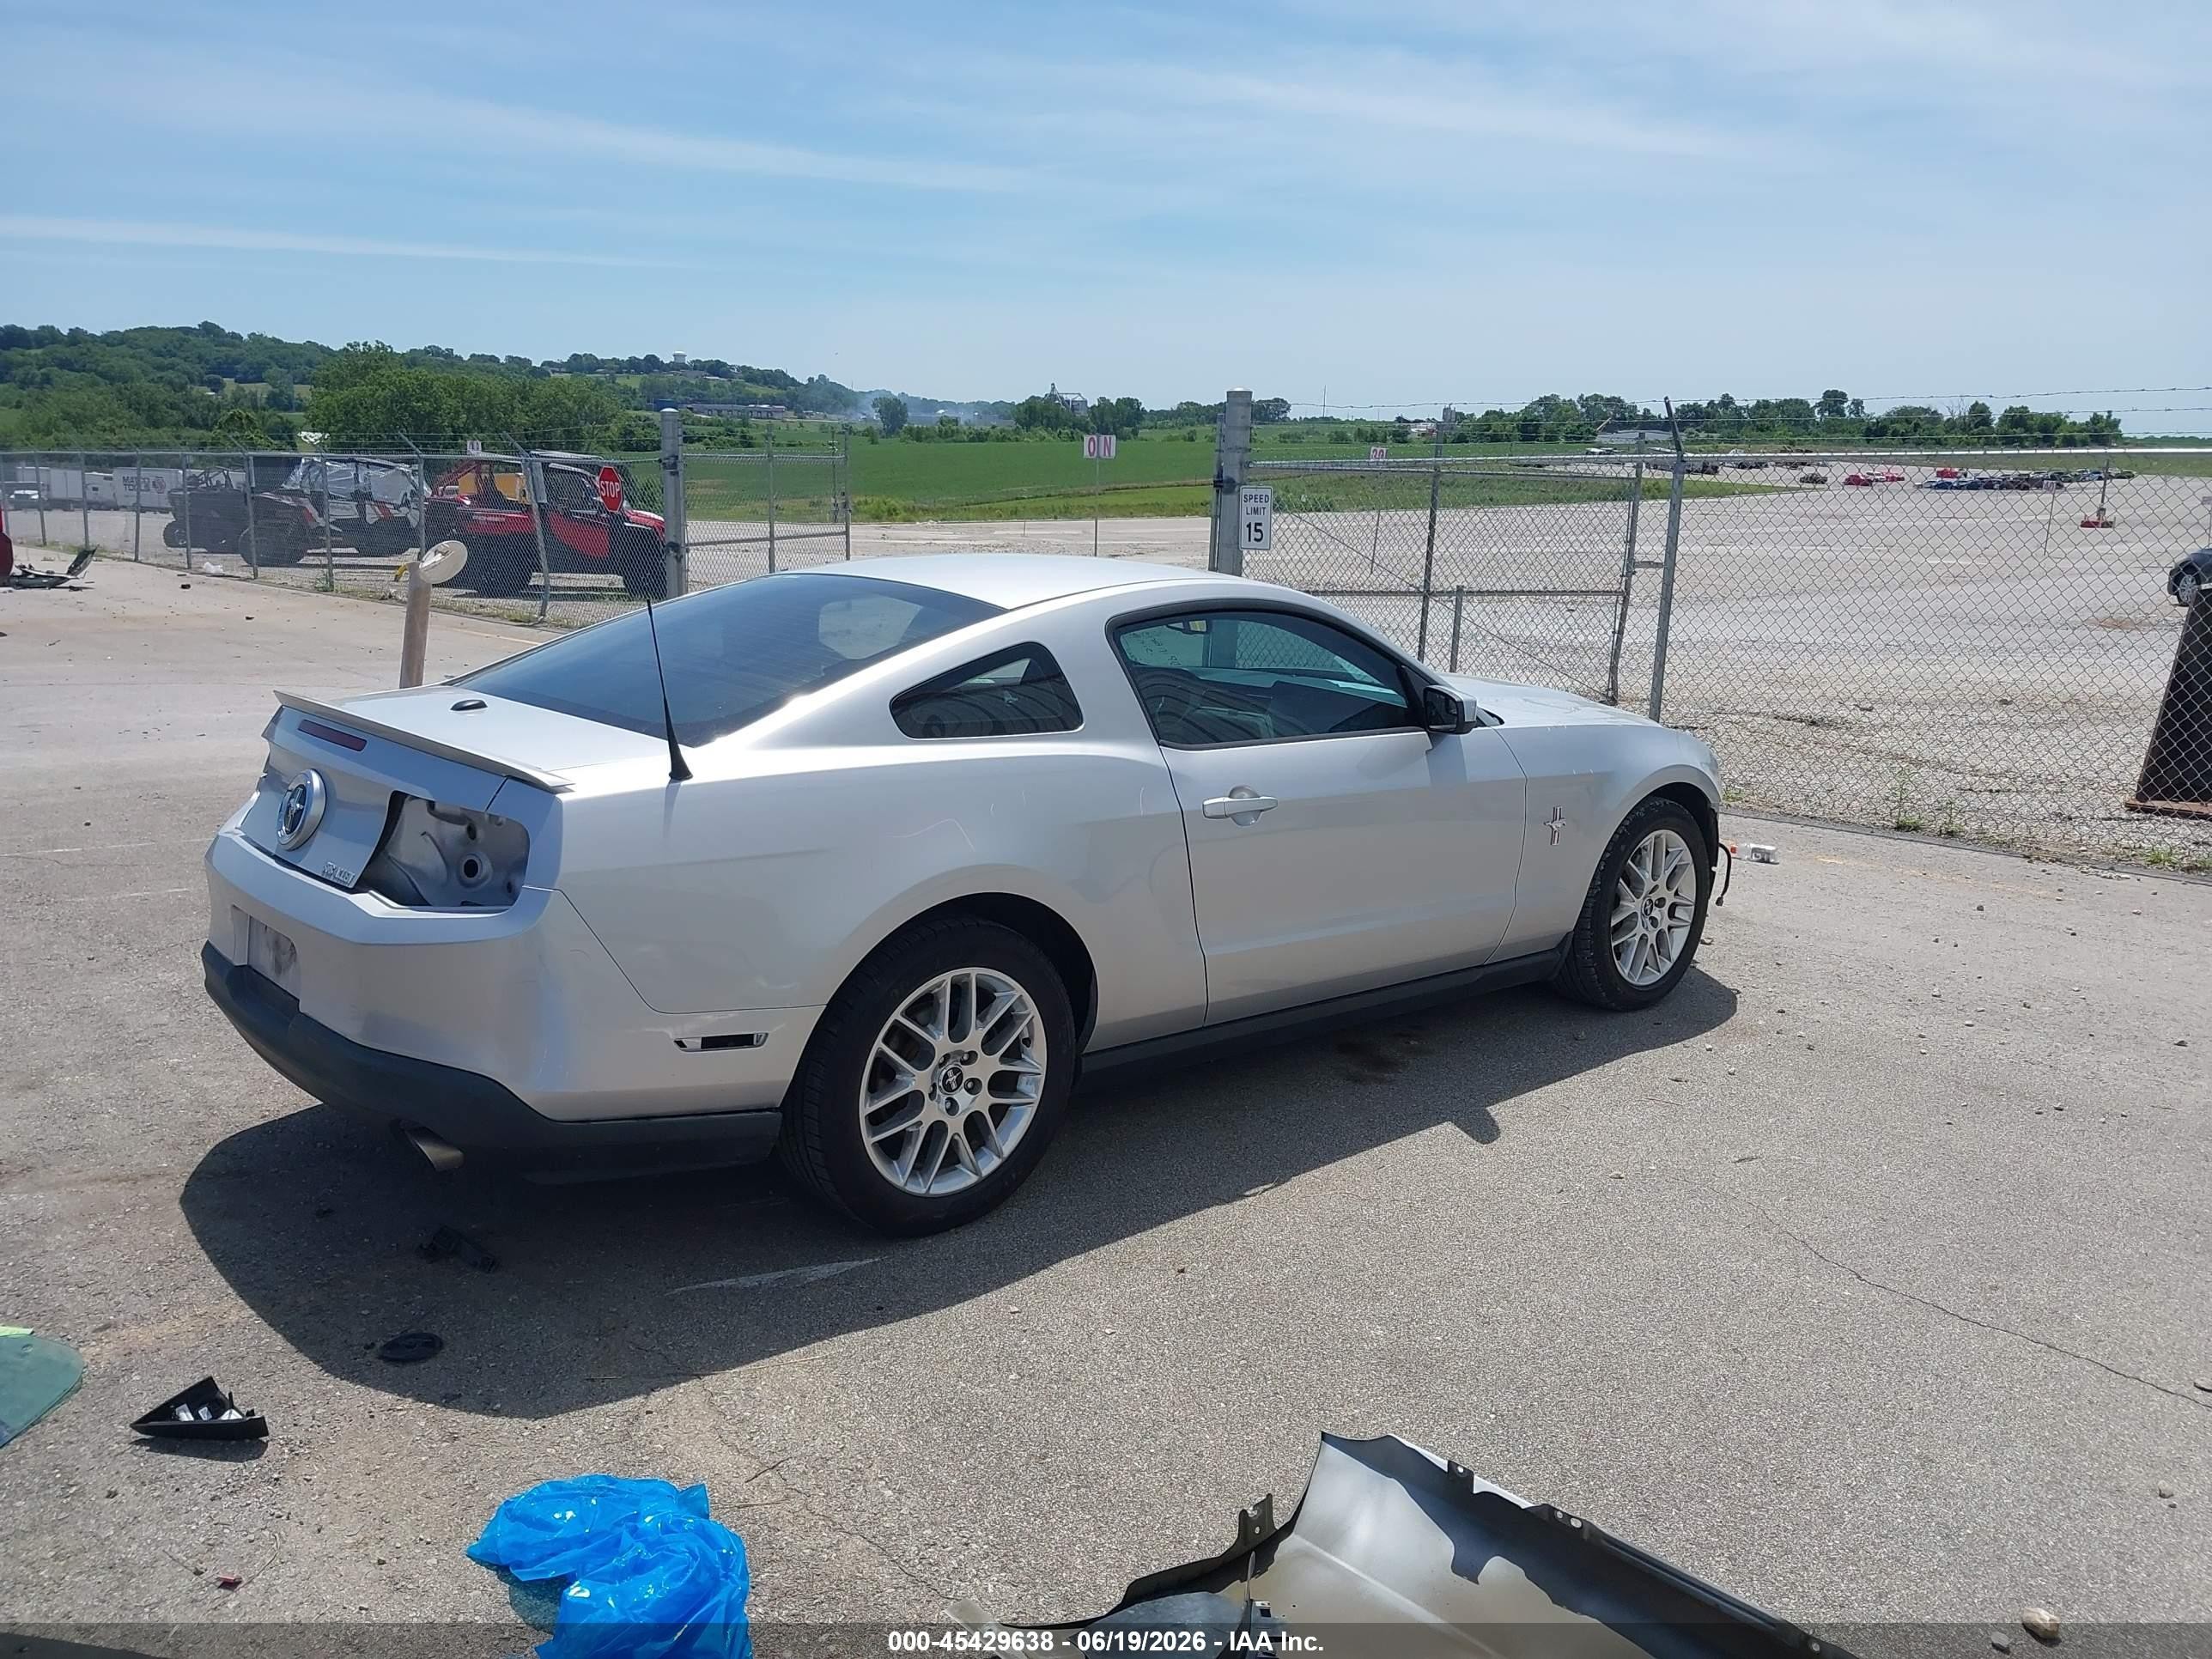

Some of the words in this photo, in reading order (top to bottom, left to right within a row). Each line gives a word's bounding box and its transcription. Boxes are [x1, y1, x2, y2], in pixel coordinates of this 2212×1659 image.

[123, 476, 150, 484] MACO
[600, 480, 620, 498] STOP
[1243, 494, 1270, 503] SPEED
[1246, 507, 1267, 516] LIMIT
[1246, 521, 1264, 543] 15
